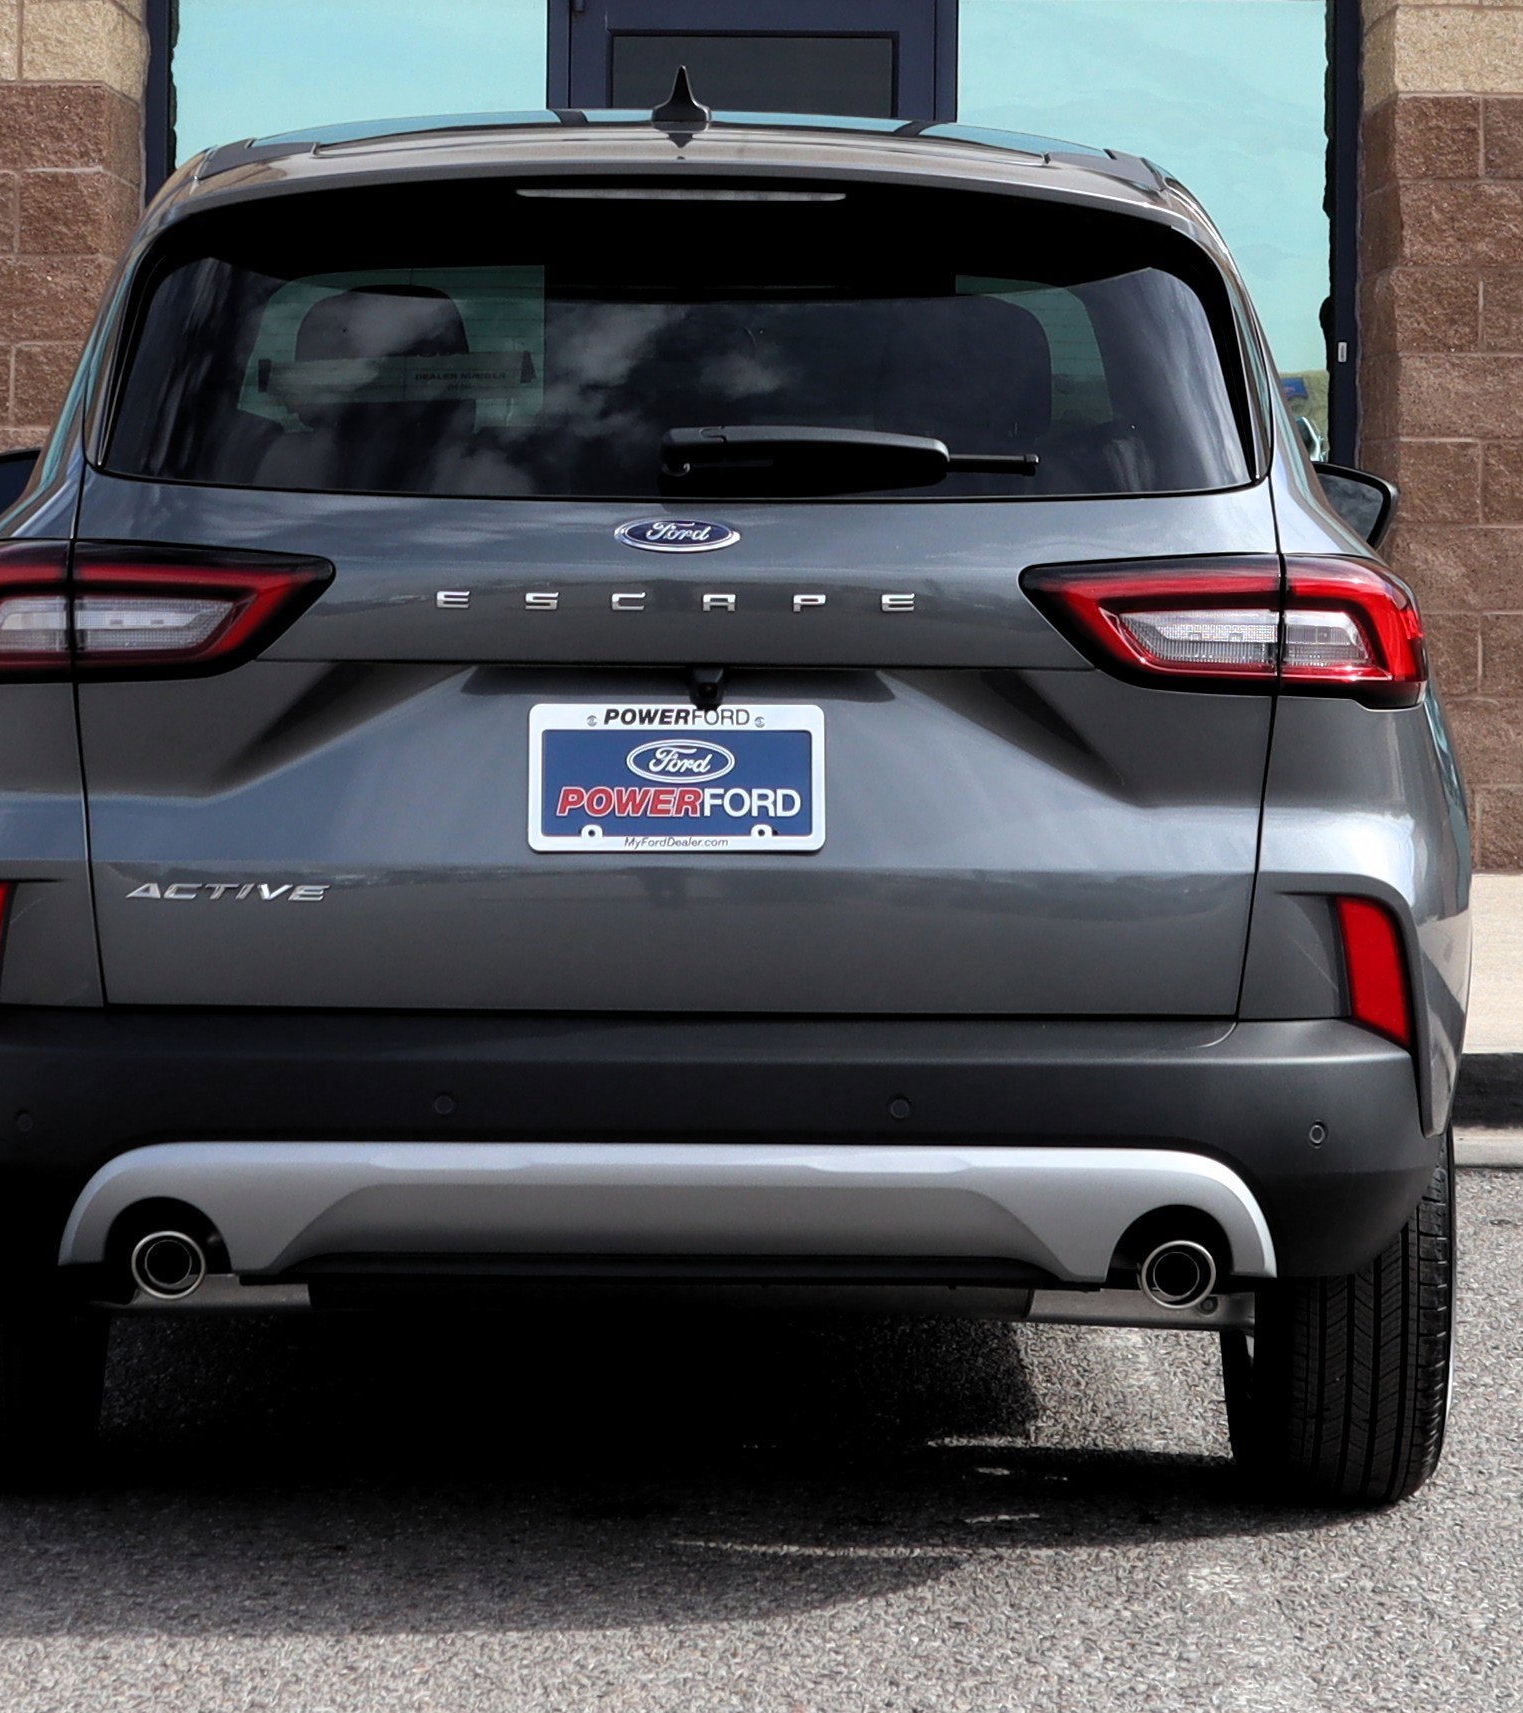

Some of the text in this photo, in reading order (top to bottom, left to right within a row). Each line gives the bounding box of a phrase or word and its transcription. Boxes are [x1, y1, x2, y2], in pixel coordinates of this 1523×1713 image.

[644, 520, 711, 543] Ford
[436, 590, 915, 612] ESCAPE
[648, 746, 712, 774] Ford
[556, 786, 802, 818] POWERFORD
[624, 836, 729, 849] MyFordDealer.com
[125, 882, 330, 901] ACTIVE
